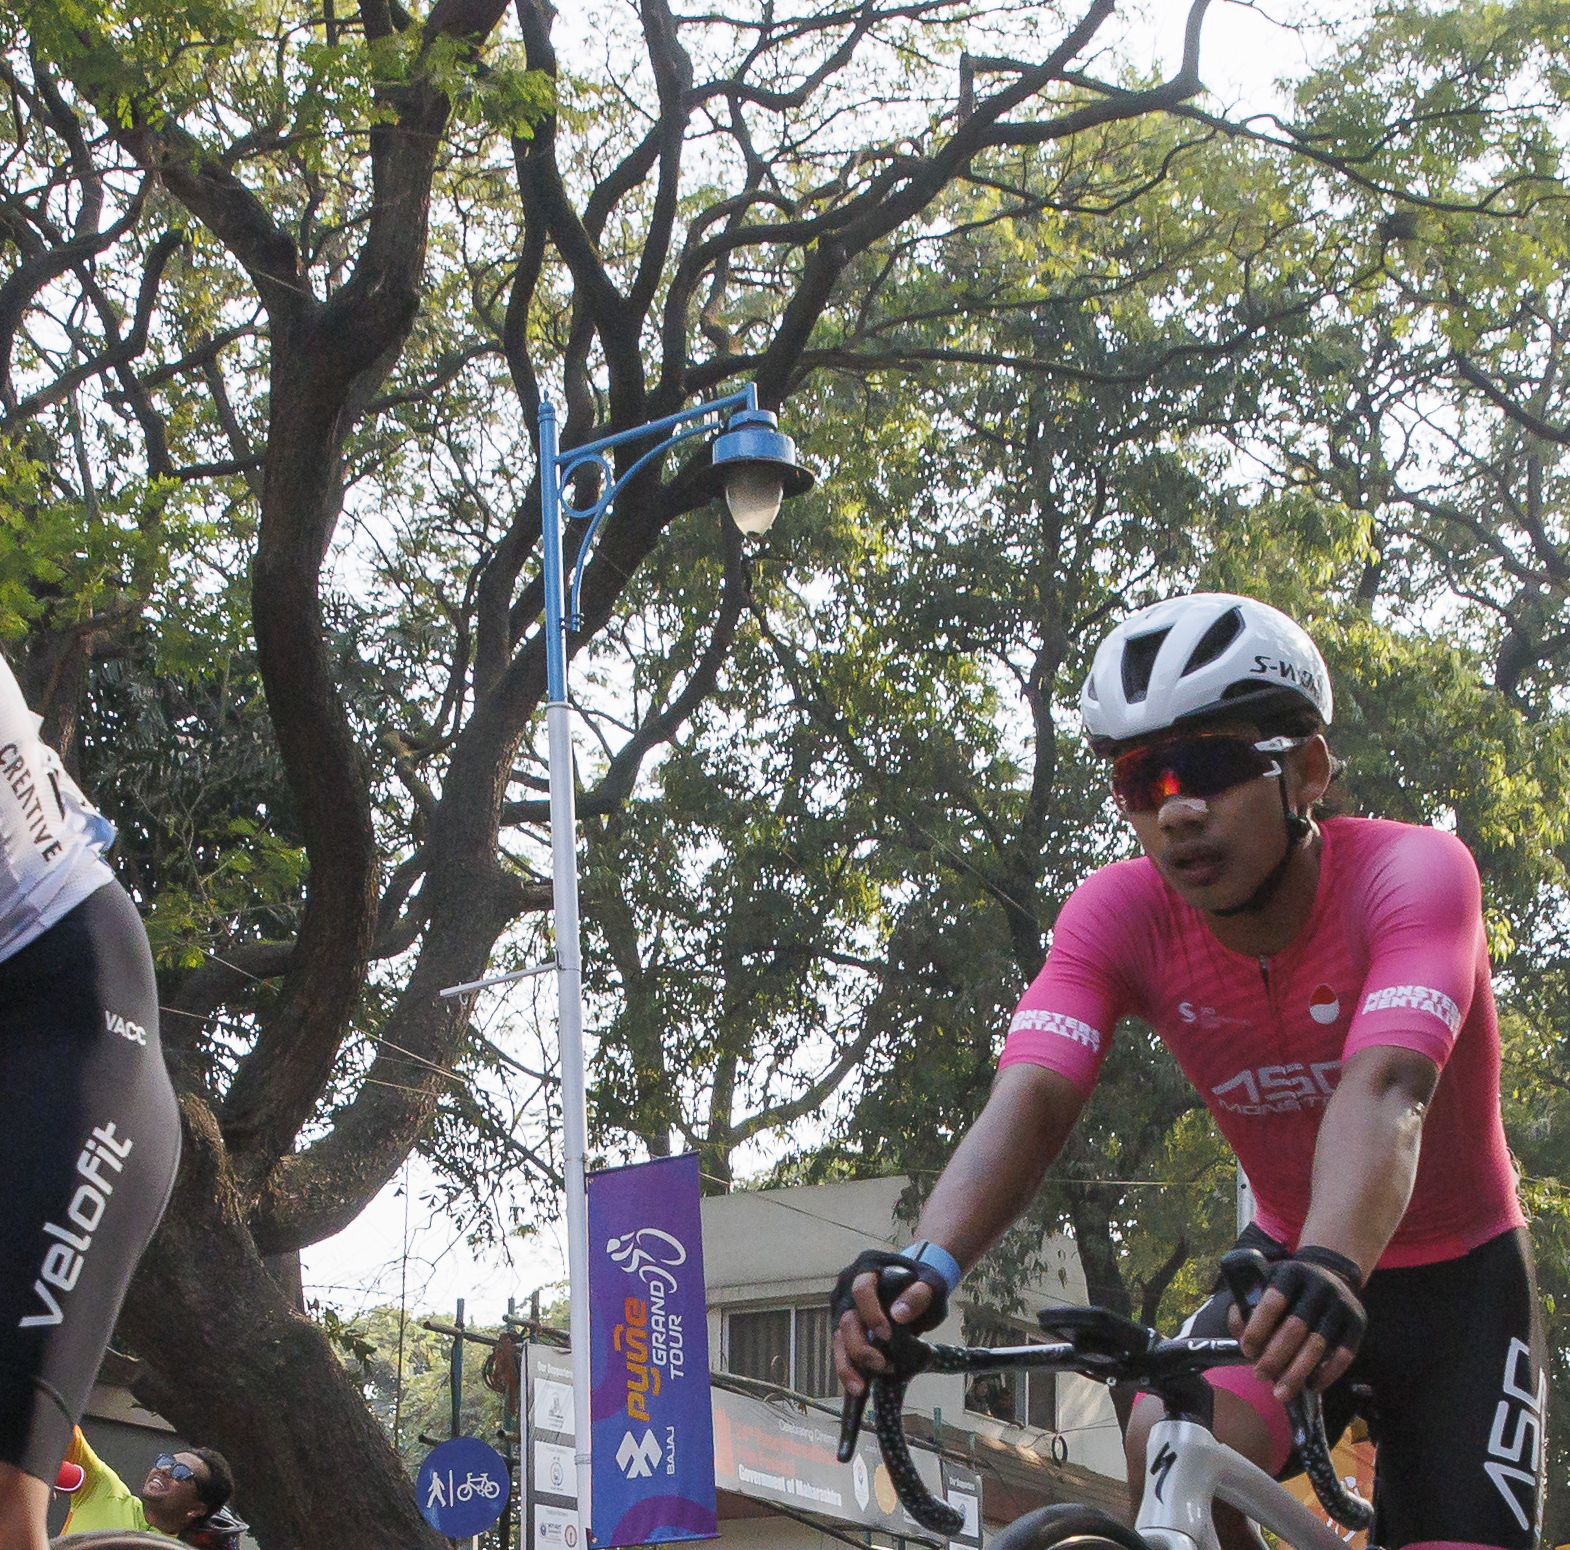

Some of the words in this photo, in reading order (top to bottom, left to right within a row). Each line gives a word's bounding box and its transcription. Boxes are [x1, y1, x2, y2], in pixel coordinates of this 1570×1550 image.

[105, 1010, 147, 1046] VACC
[18, 1121, 133, 1327] velofit
[650, 1279, 668, 1366] GRAND
[668, 1314, 686, 1380] TOUR
[666, 1426, 677, 1476] BAJAJ
